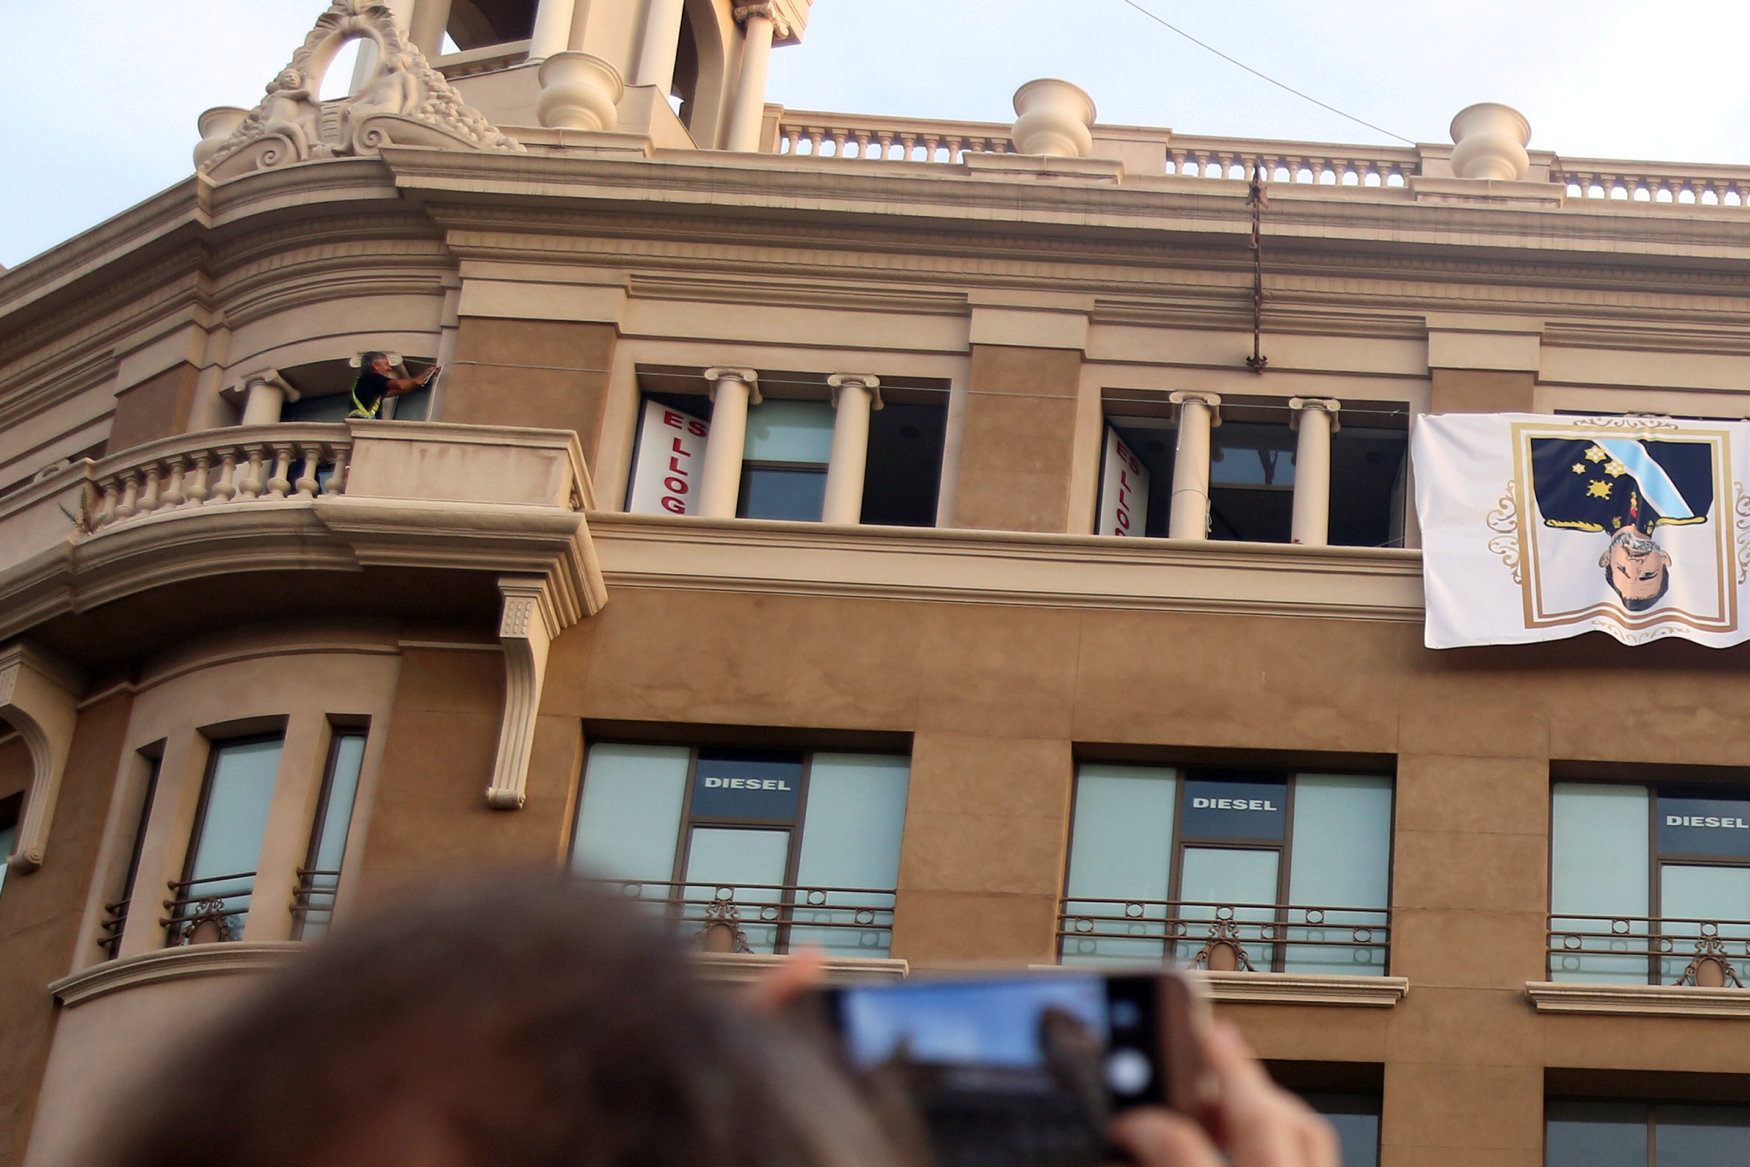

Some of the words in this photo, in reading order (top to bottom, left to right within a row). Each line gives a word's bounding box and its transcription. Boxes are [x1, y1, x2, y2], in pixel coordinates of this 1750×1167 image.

[663, 410, 708, 438] ES
[704, 777, 792, 791] DIESEL
[1192, 797, 1278, 811] DIESEL
[1666, 815, 1750, 829] DIESEL
